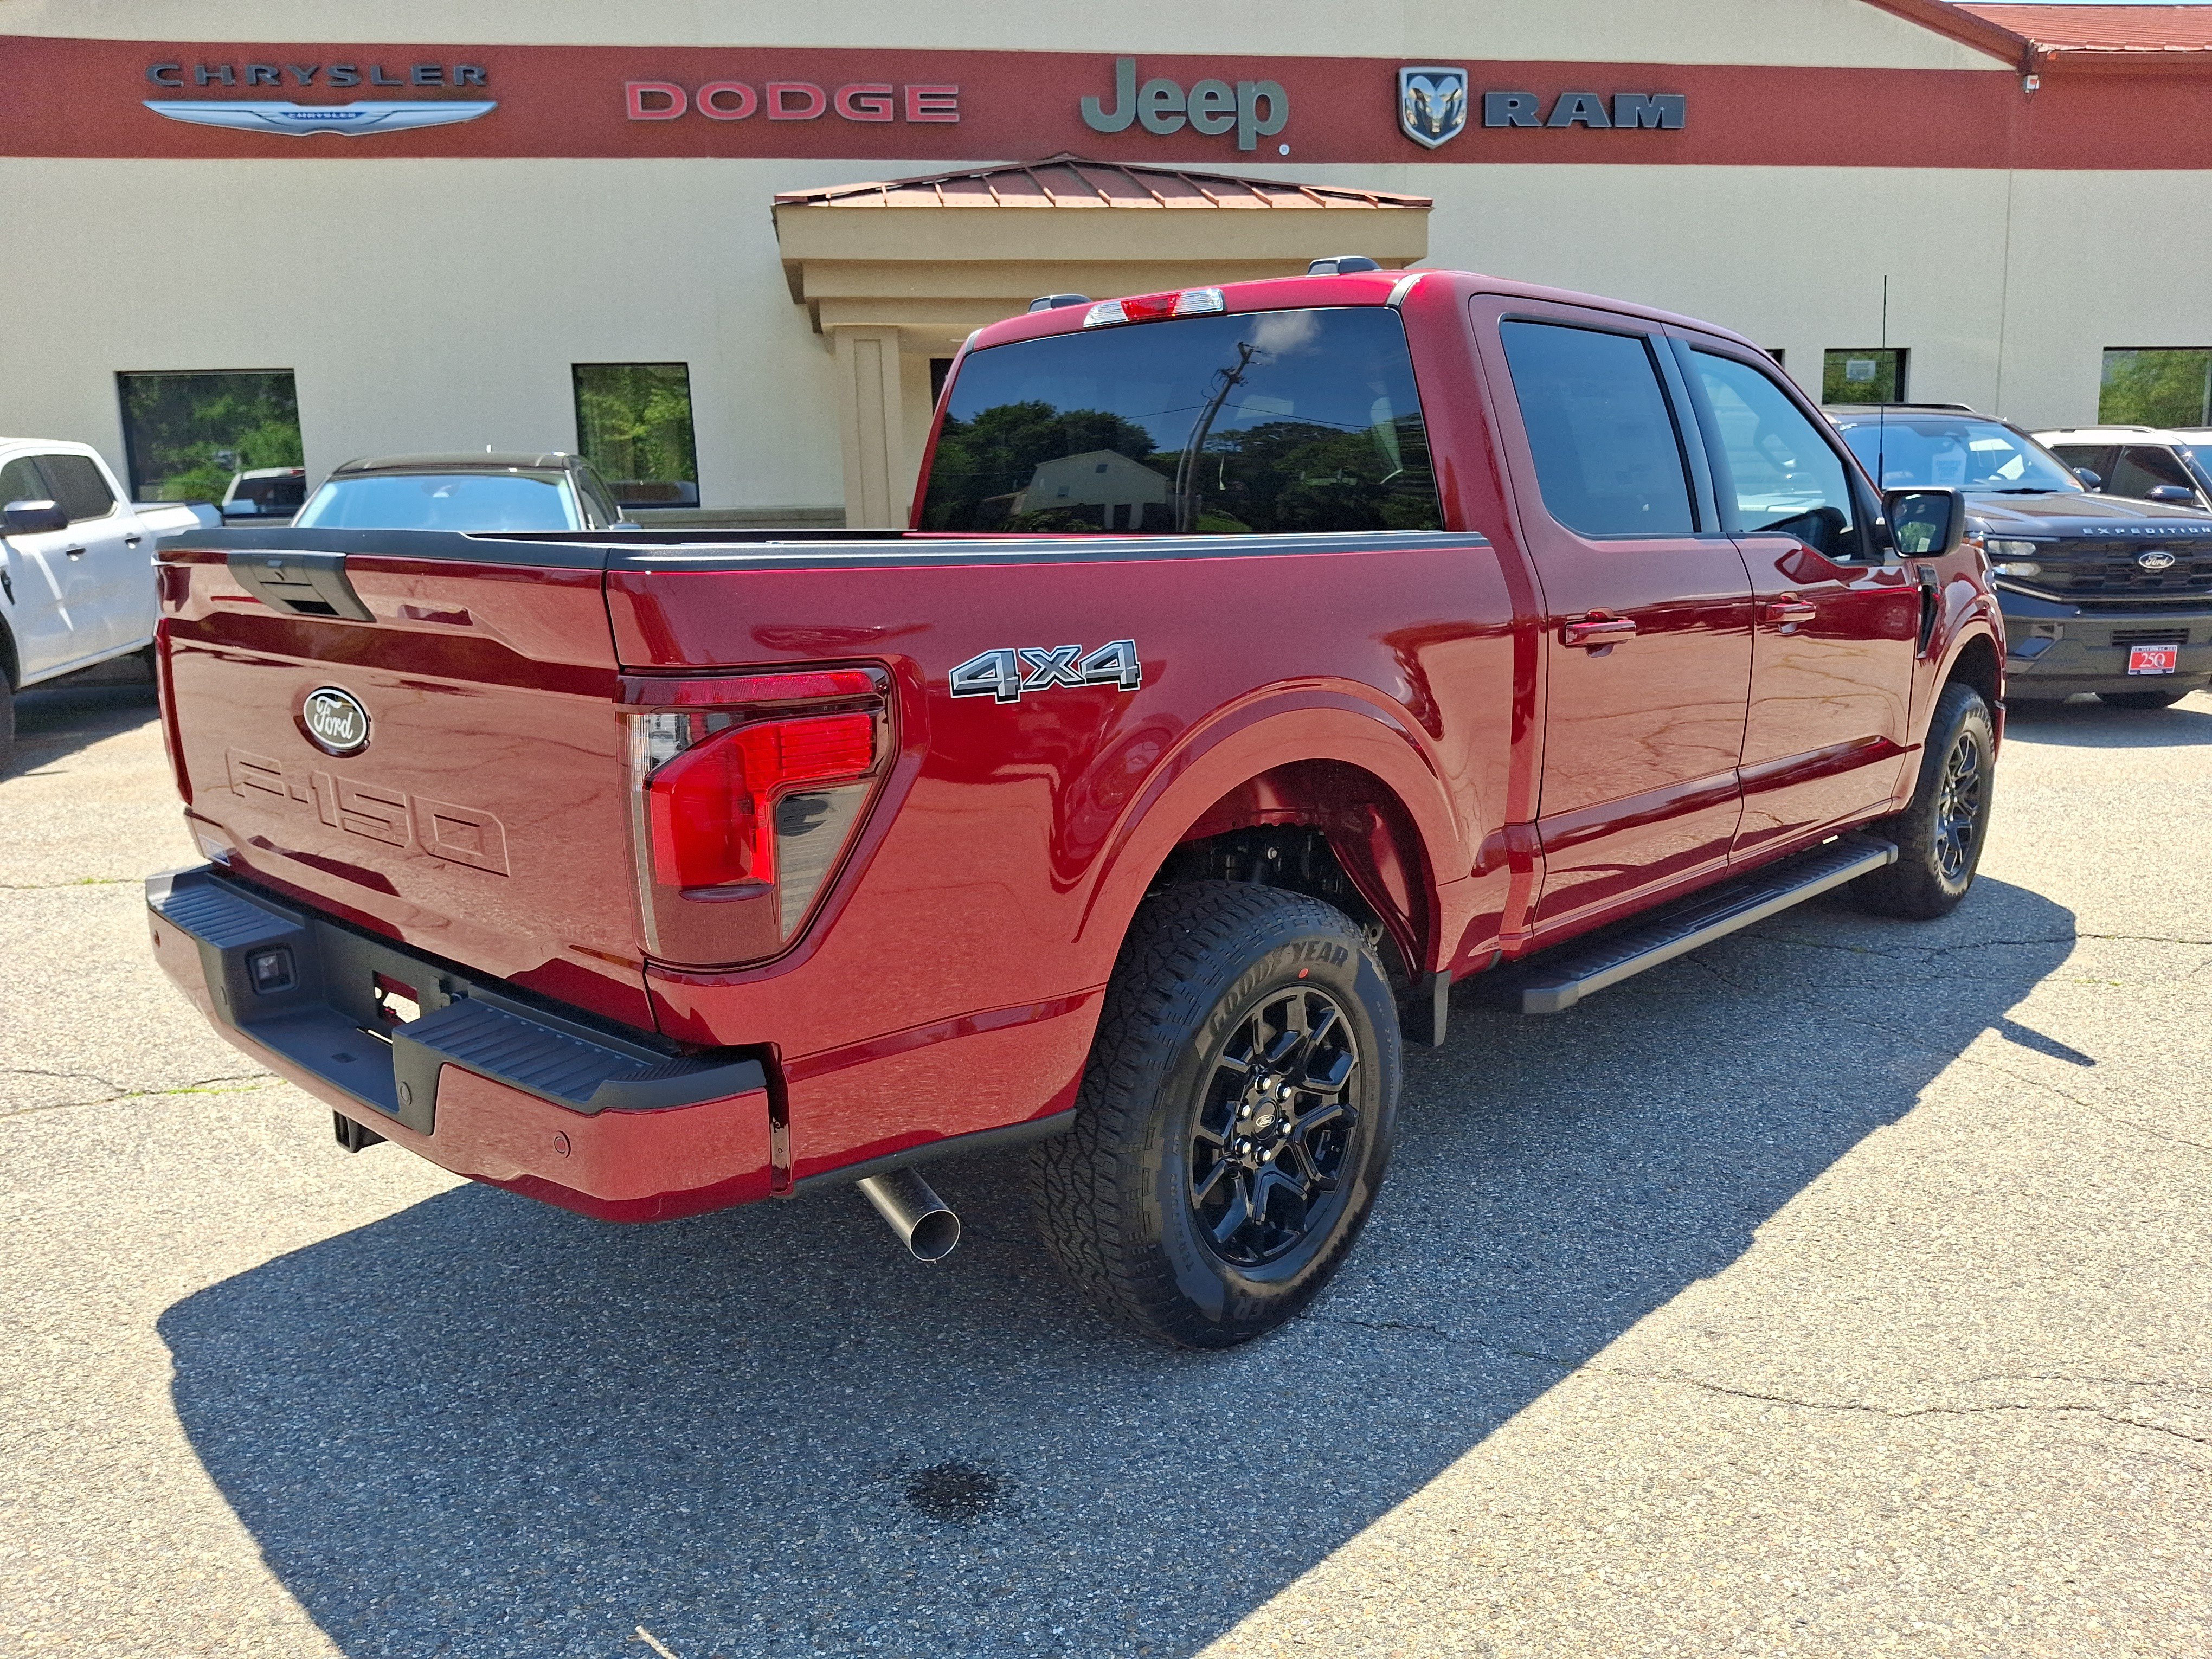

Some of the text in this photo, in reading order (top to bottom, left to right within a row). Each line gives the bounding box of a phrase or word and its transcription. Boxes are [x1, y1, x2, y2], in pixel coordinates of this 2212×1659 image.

[145, 63, 487, 87] CHRYSLER
[624, 80, 960, 123] DODGE
[1081, 57, 1289, 150] Jeep
[1483, 91, 1686, 129] RAM
[2082, 526, 2211, 535] EXPEDITION
[2145, 554, 2169, 567] Ford
[313, 695, 353, 740] Ford
[225, 747, 511, 878] F-150
[1258, 1116, 1273, 1126] Ford
